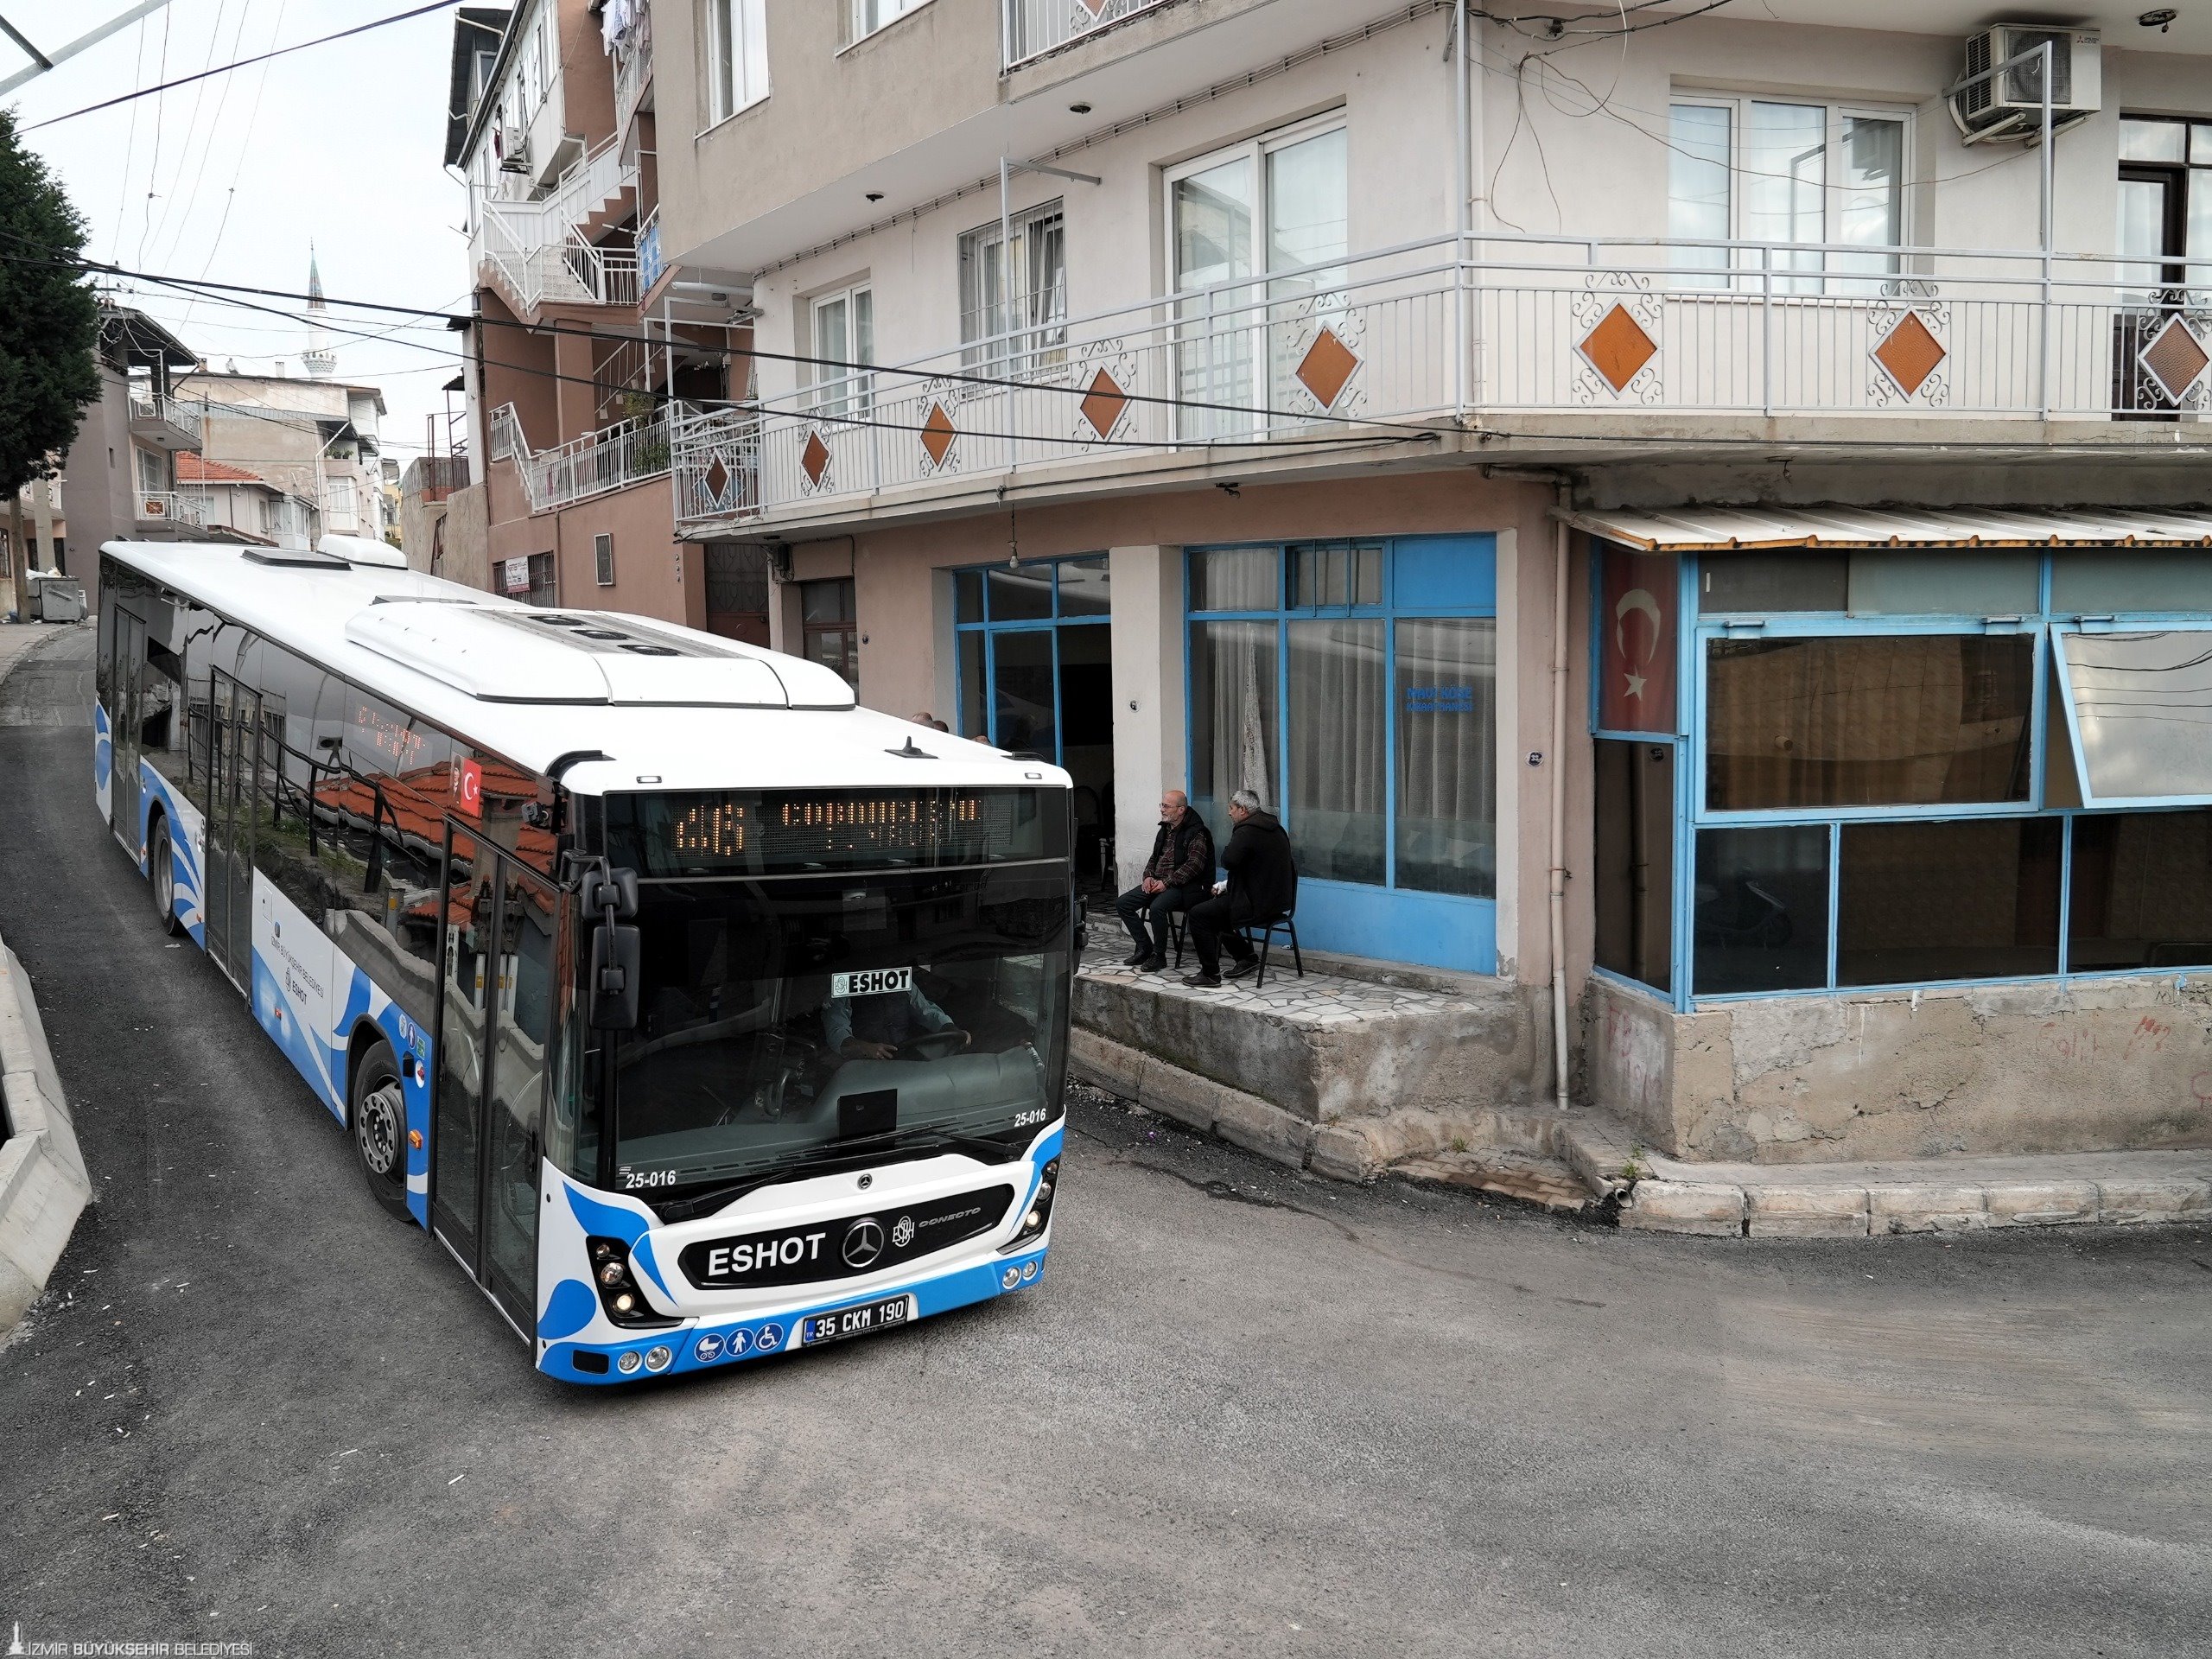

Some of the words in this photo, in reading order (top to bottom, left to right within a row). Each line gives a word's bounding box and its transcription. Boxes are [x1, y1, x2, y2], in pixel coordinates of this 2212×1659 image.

[292, 980, 308, 1005] ESHOT
[849, 969, 909, 993] ESHOT
[1014, 1108, 1046, 1127] 25-016
[626, 1170, 677, 1189] 25-016
[918, 1207, 982, 1228] CONECTO
[708, 1232, 826, 1276] ESHOT
[816, 1317, 836, 1338] 35
[842, 1308, 872, 1332] CKM
[879, 1300, 905, 1323] 190
